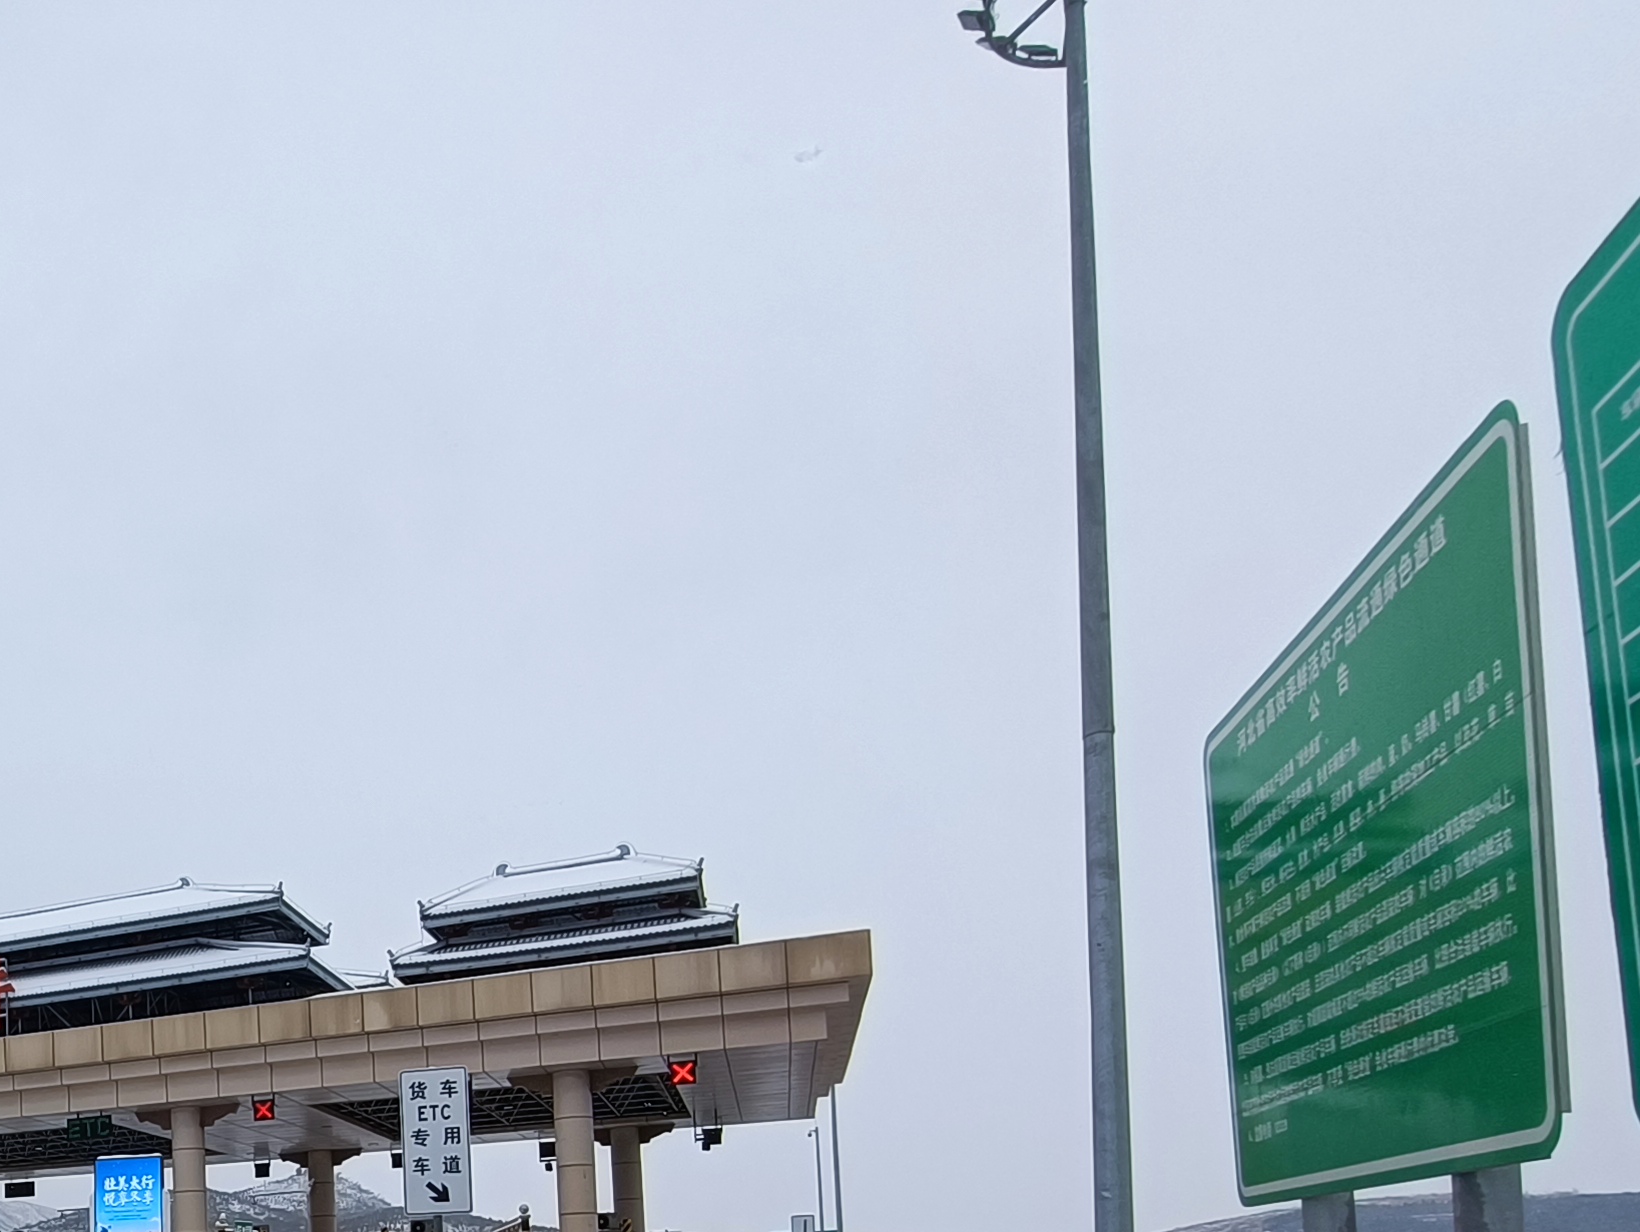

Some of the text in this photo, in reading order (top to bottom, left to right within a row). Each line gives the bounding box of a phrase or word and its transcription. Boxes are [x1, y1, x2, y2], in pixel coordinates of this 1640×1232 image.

[408, 1079, 459, 1101] 货车
[417, 1104, 452, 1122] ETC
[68, 1117, 110, 1139] ETC
[410, 1126, 462, 1147] 专用
[412, 1155, 462, 1177] 车道
[103, 1175, 156, 1191] 壮美太行
